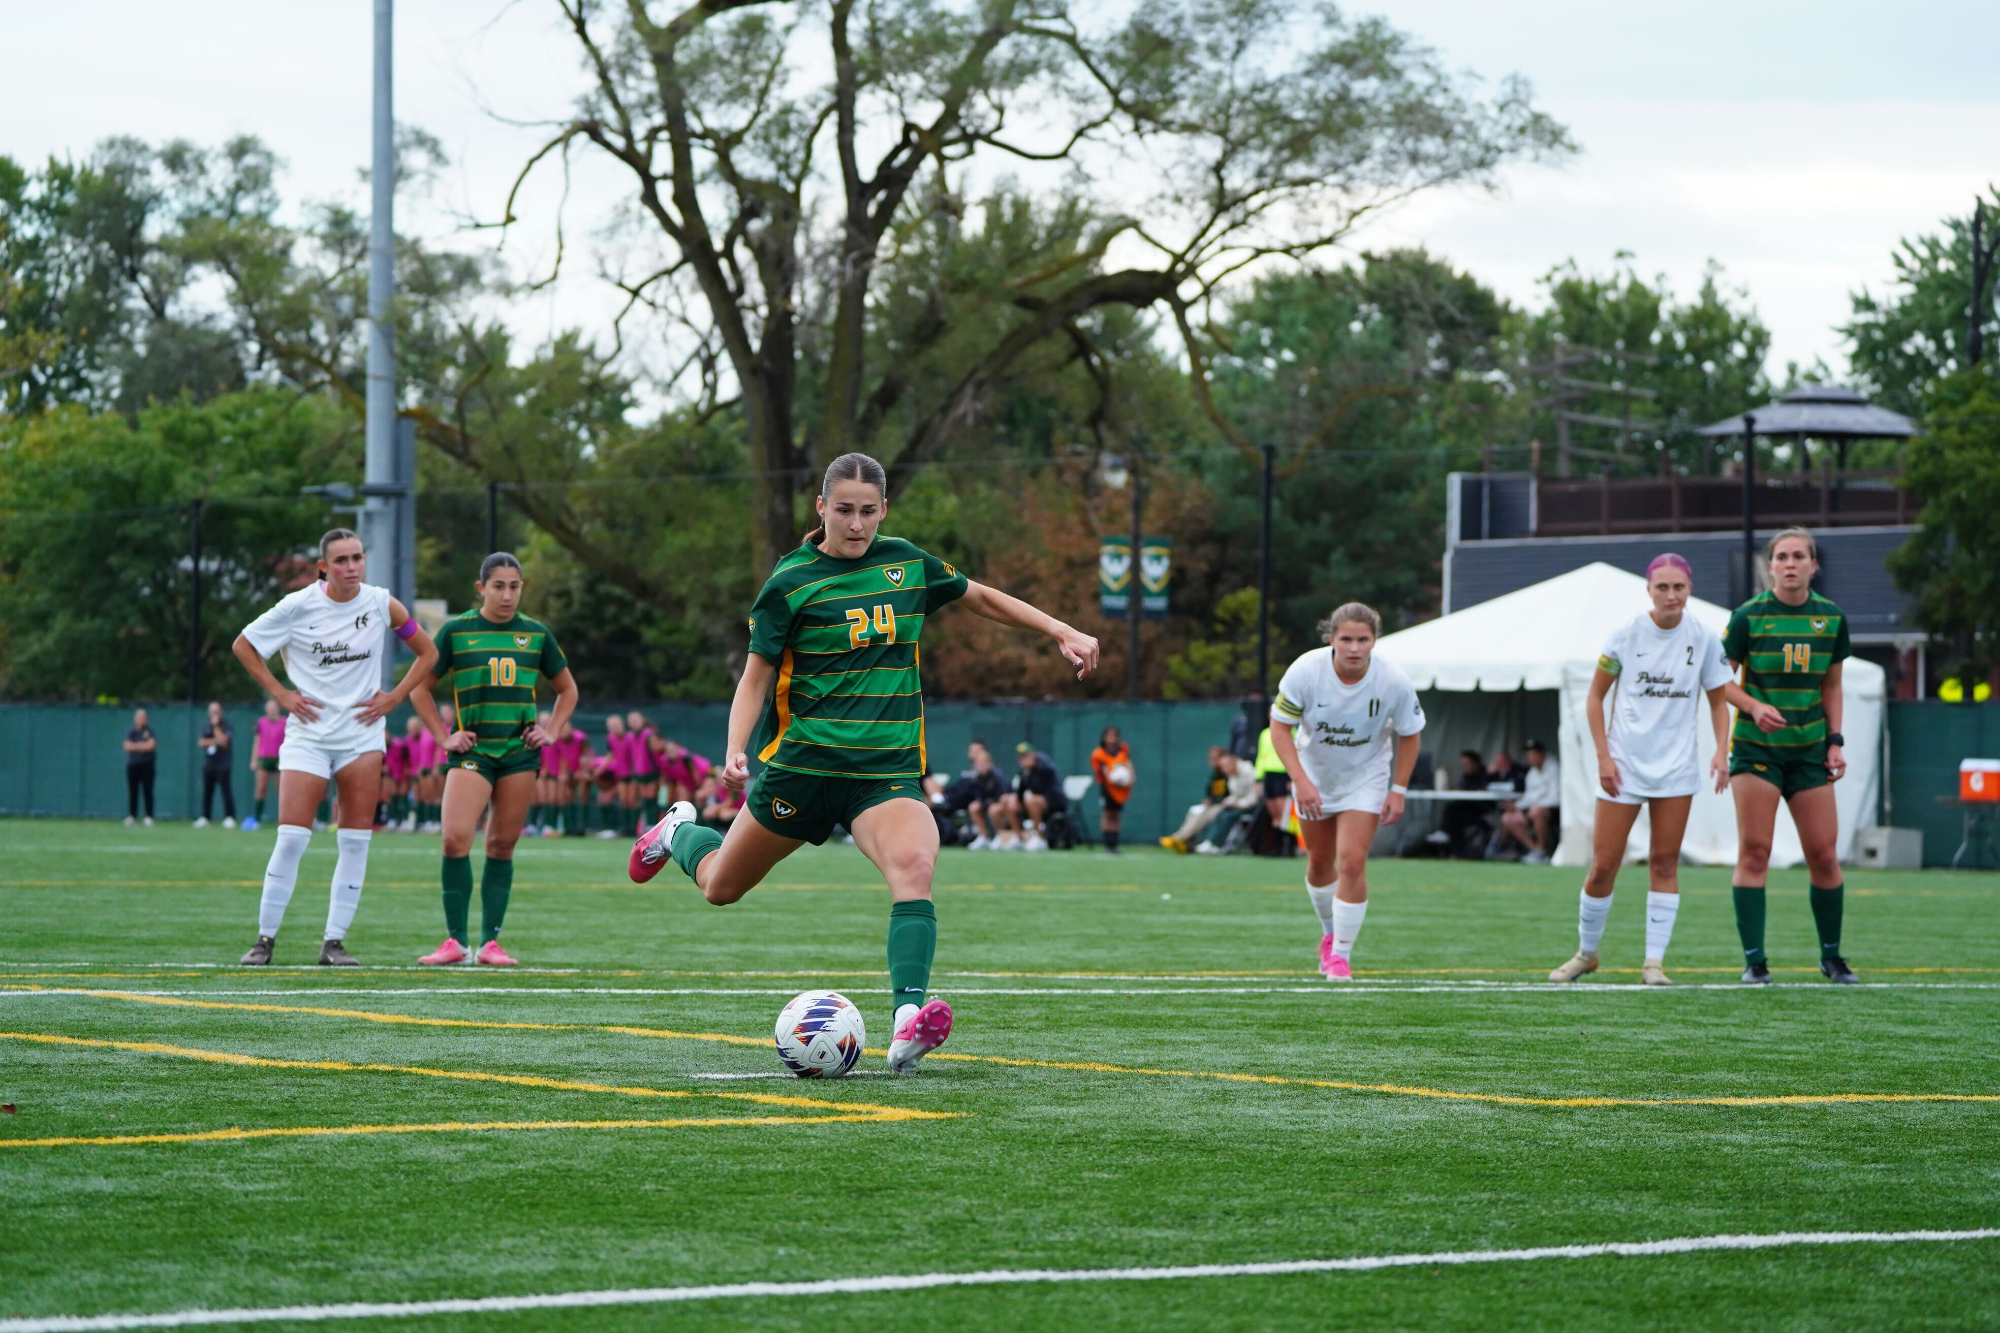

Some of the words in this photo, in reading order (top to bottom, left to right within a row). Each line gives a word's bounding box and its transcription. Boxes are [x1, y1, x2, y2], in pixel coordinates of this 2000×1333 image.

[845, 604, 896, 650] 24
[311, 640, 350, 654] Purdue
[1686, 645, 1694, 666] 2
[319, 649, 371, 667] Northwest
[1782, 643, 1811, 673] 14
[488, 657, 516, 686] 10
[1636, 671, 1674, 684] Purdue
[1639, 686, 1691, 698] Northwest
[1369, 698, 1380, 717] 11
[1315, 721, 1355, 735] Purdue
